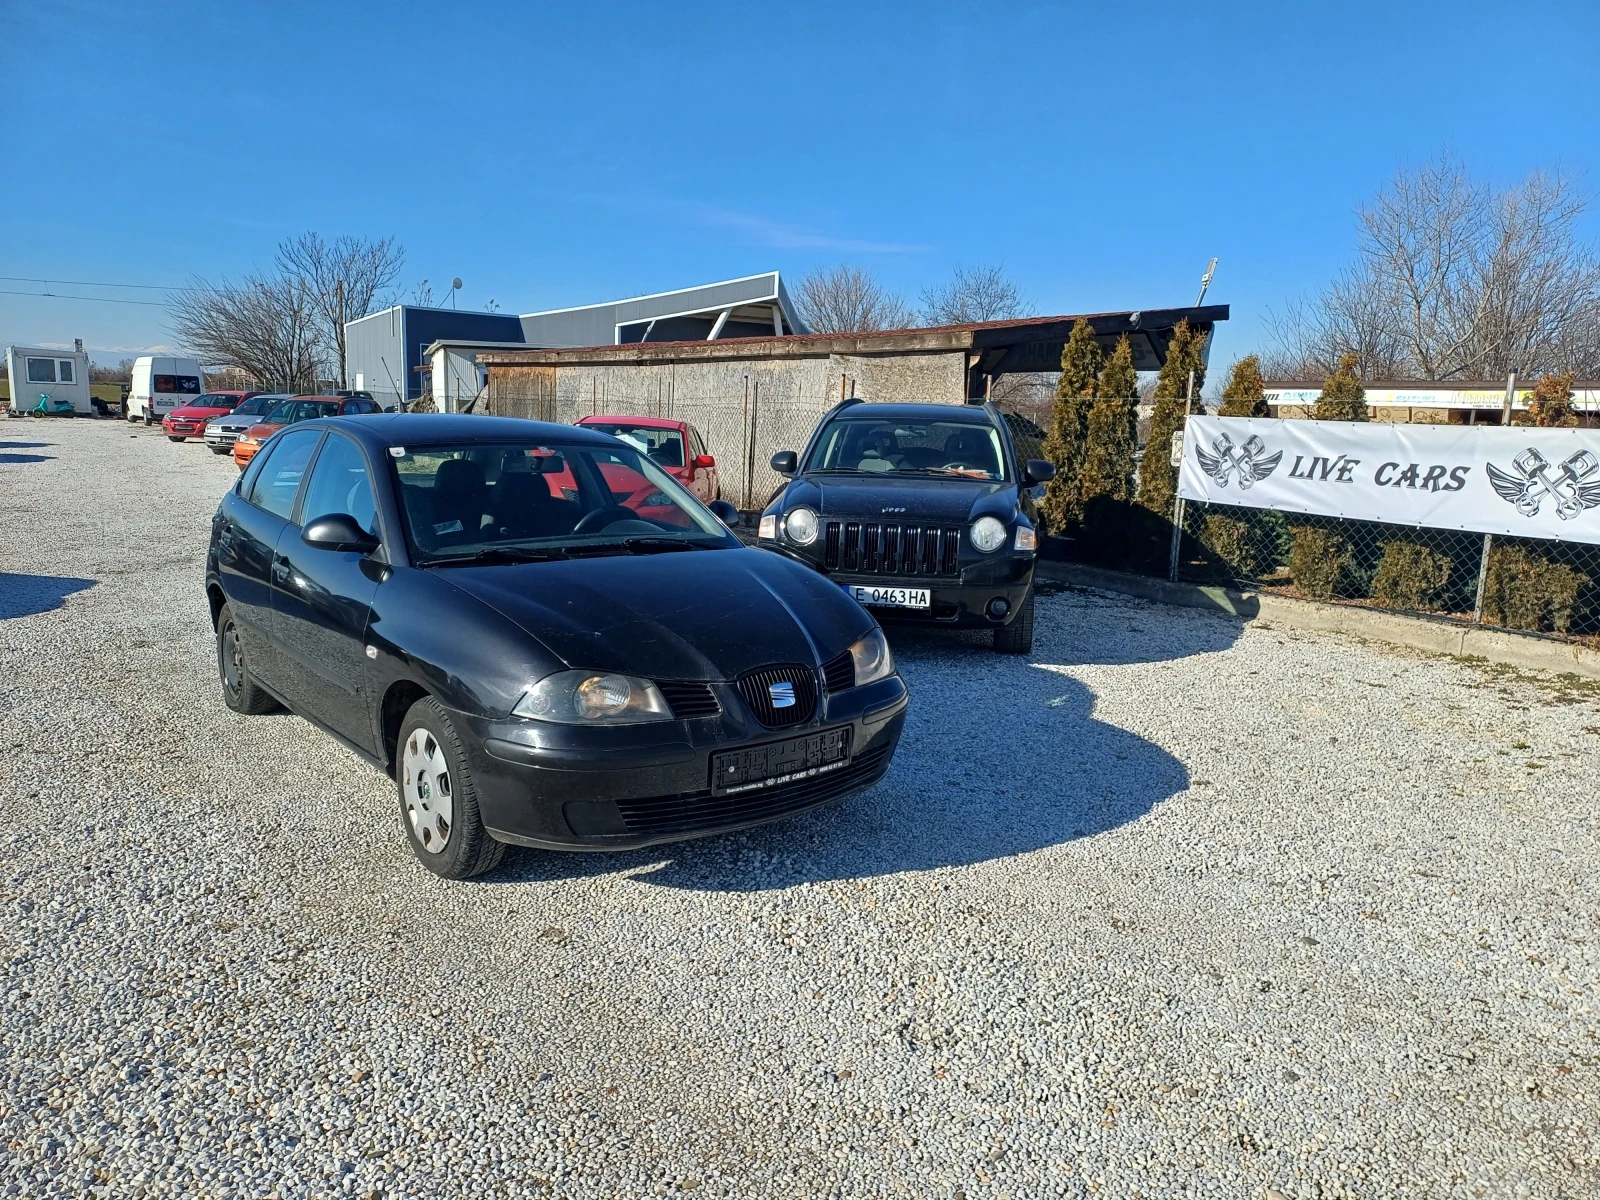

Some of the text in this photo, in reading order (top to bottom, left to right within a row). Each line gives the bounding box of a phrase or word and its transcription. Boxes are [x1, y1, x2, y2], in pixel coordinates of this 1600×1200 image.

[1288, 454, 1472, 493] LIVE CARS
[856, 588, 927, 605] E 0463 HA
[777, 774, 791, 784] LIVE
[792, 771, 807, 780] CARS
